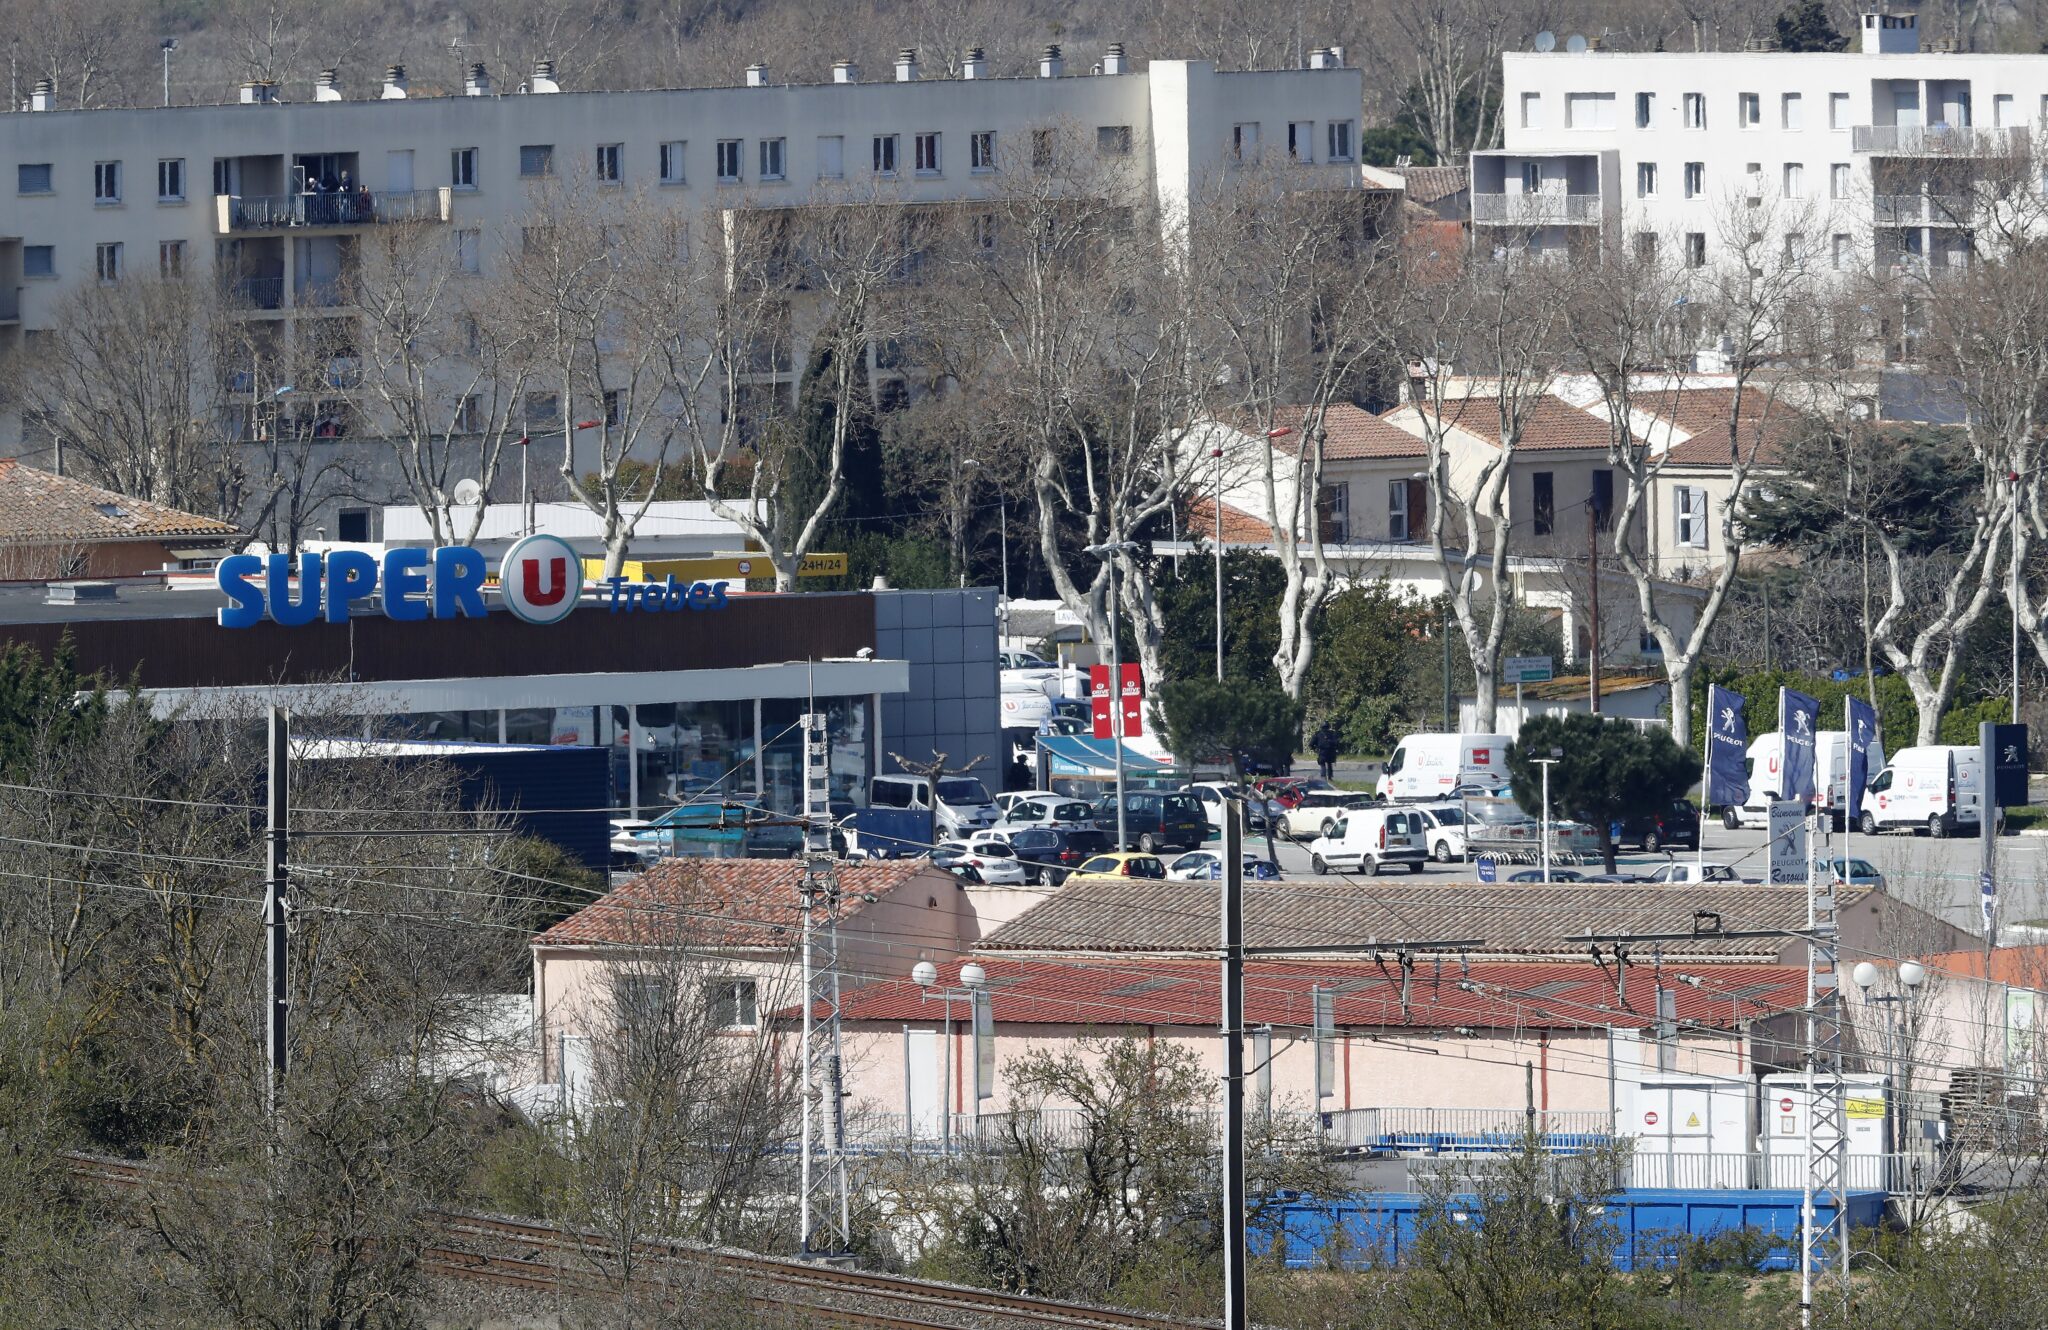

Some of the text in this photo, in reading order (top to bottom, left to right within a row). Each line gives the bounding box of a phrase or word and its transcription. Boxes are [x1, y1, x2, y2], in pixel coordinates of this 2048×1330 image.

[801, 559, 841, 571] 24H/24
[217, 546, 730, 628] SUPER U Trèbes
[1713, 732, 1743, 747] PEUGEOT
[1772, 859, 1805, 867] PEUGEOT
